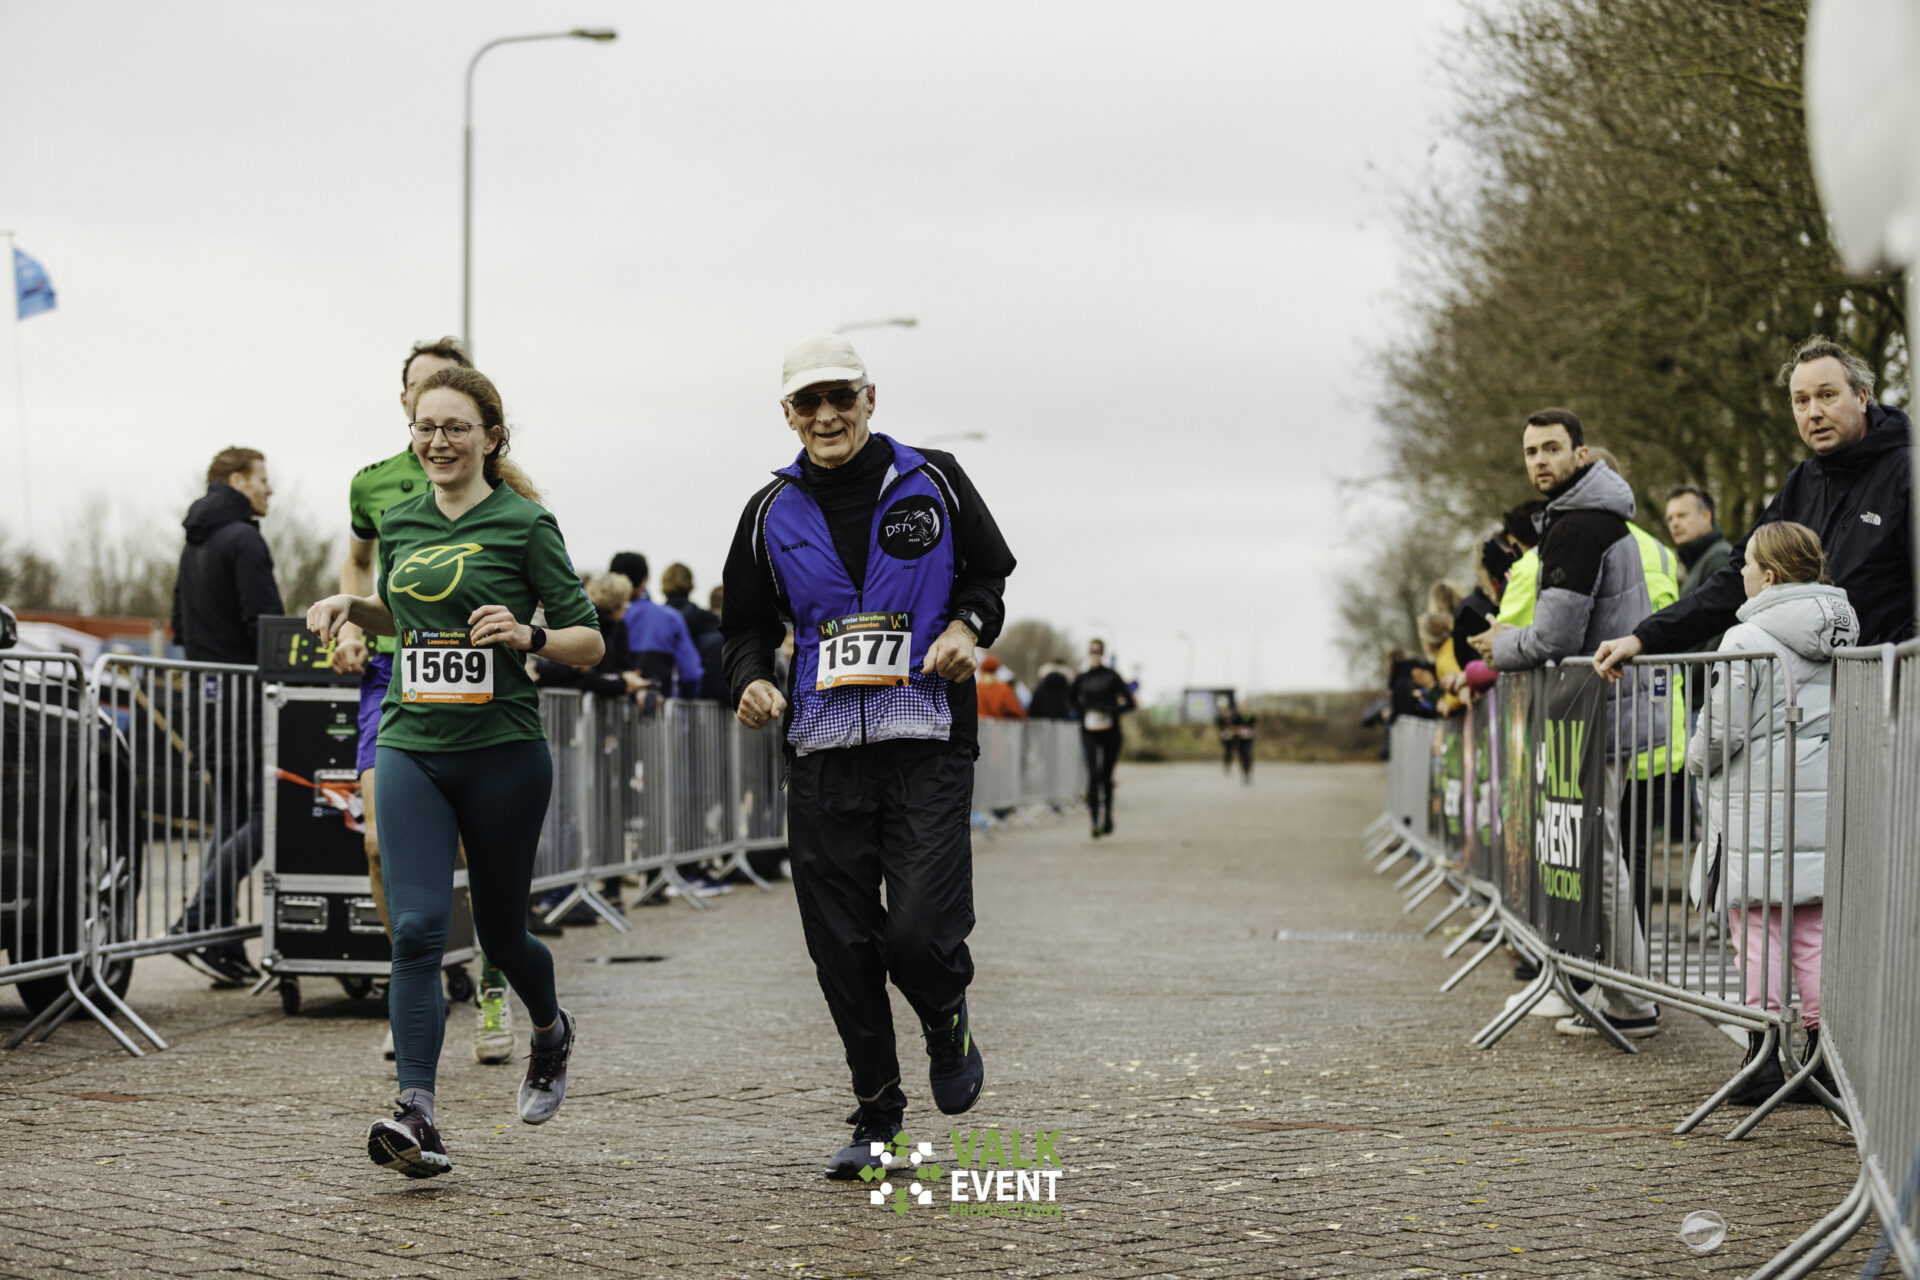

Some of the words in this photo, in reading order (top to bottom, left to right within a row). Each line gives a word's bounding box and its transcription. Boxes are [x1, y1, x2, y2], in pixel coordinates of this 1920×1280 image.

[885, 523, 917, 538] DSTV
[841, 617, 859, 625] Winter
[859, 614, 886, 622] Marathon
[846, 621, 880, 631] Leeuwarden
[825, 634, 904, 670] 1577
[406, 650, 487, 684] 1569
[1545, 718, 1585, 799] ALK
